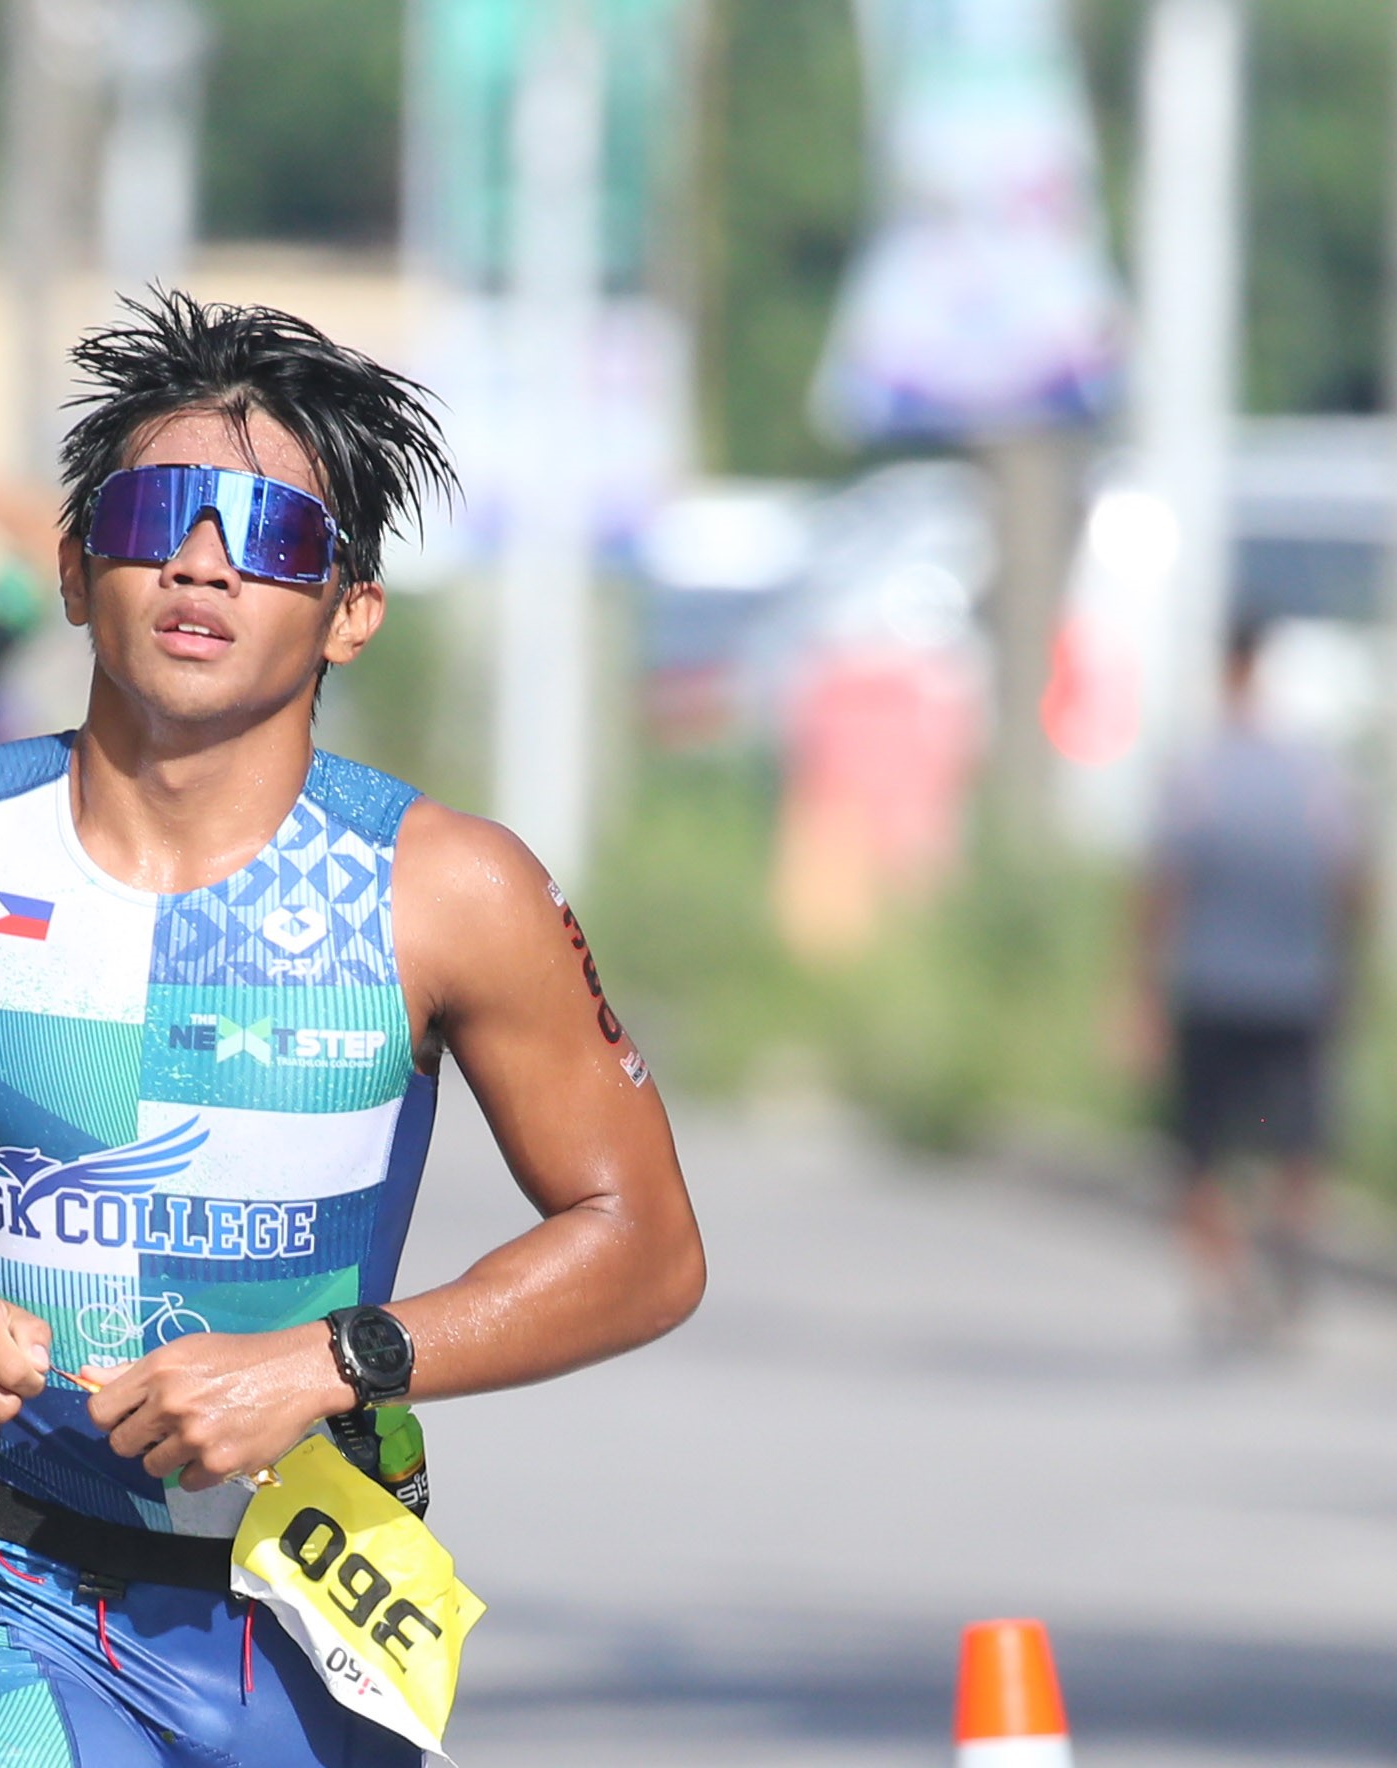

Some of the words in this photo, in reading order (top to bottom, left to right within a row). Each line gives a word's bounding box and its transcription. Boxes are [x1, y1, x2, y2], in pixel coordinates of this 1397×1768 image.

[294, 1028, 386, 1060] STEP
[54, 1190, 318, 1260] COLLEGE
[278, 1506, 443, 1674] 360
